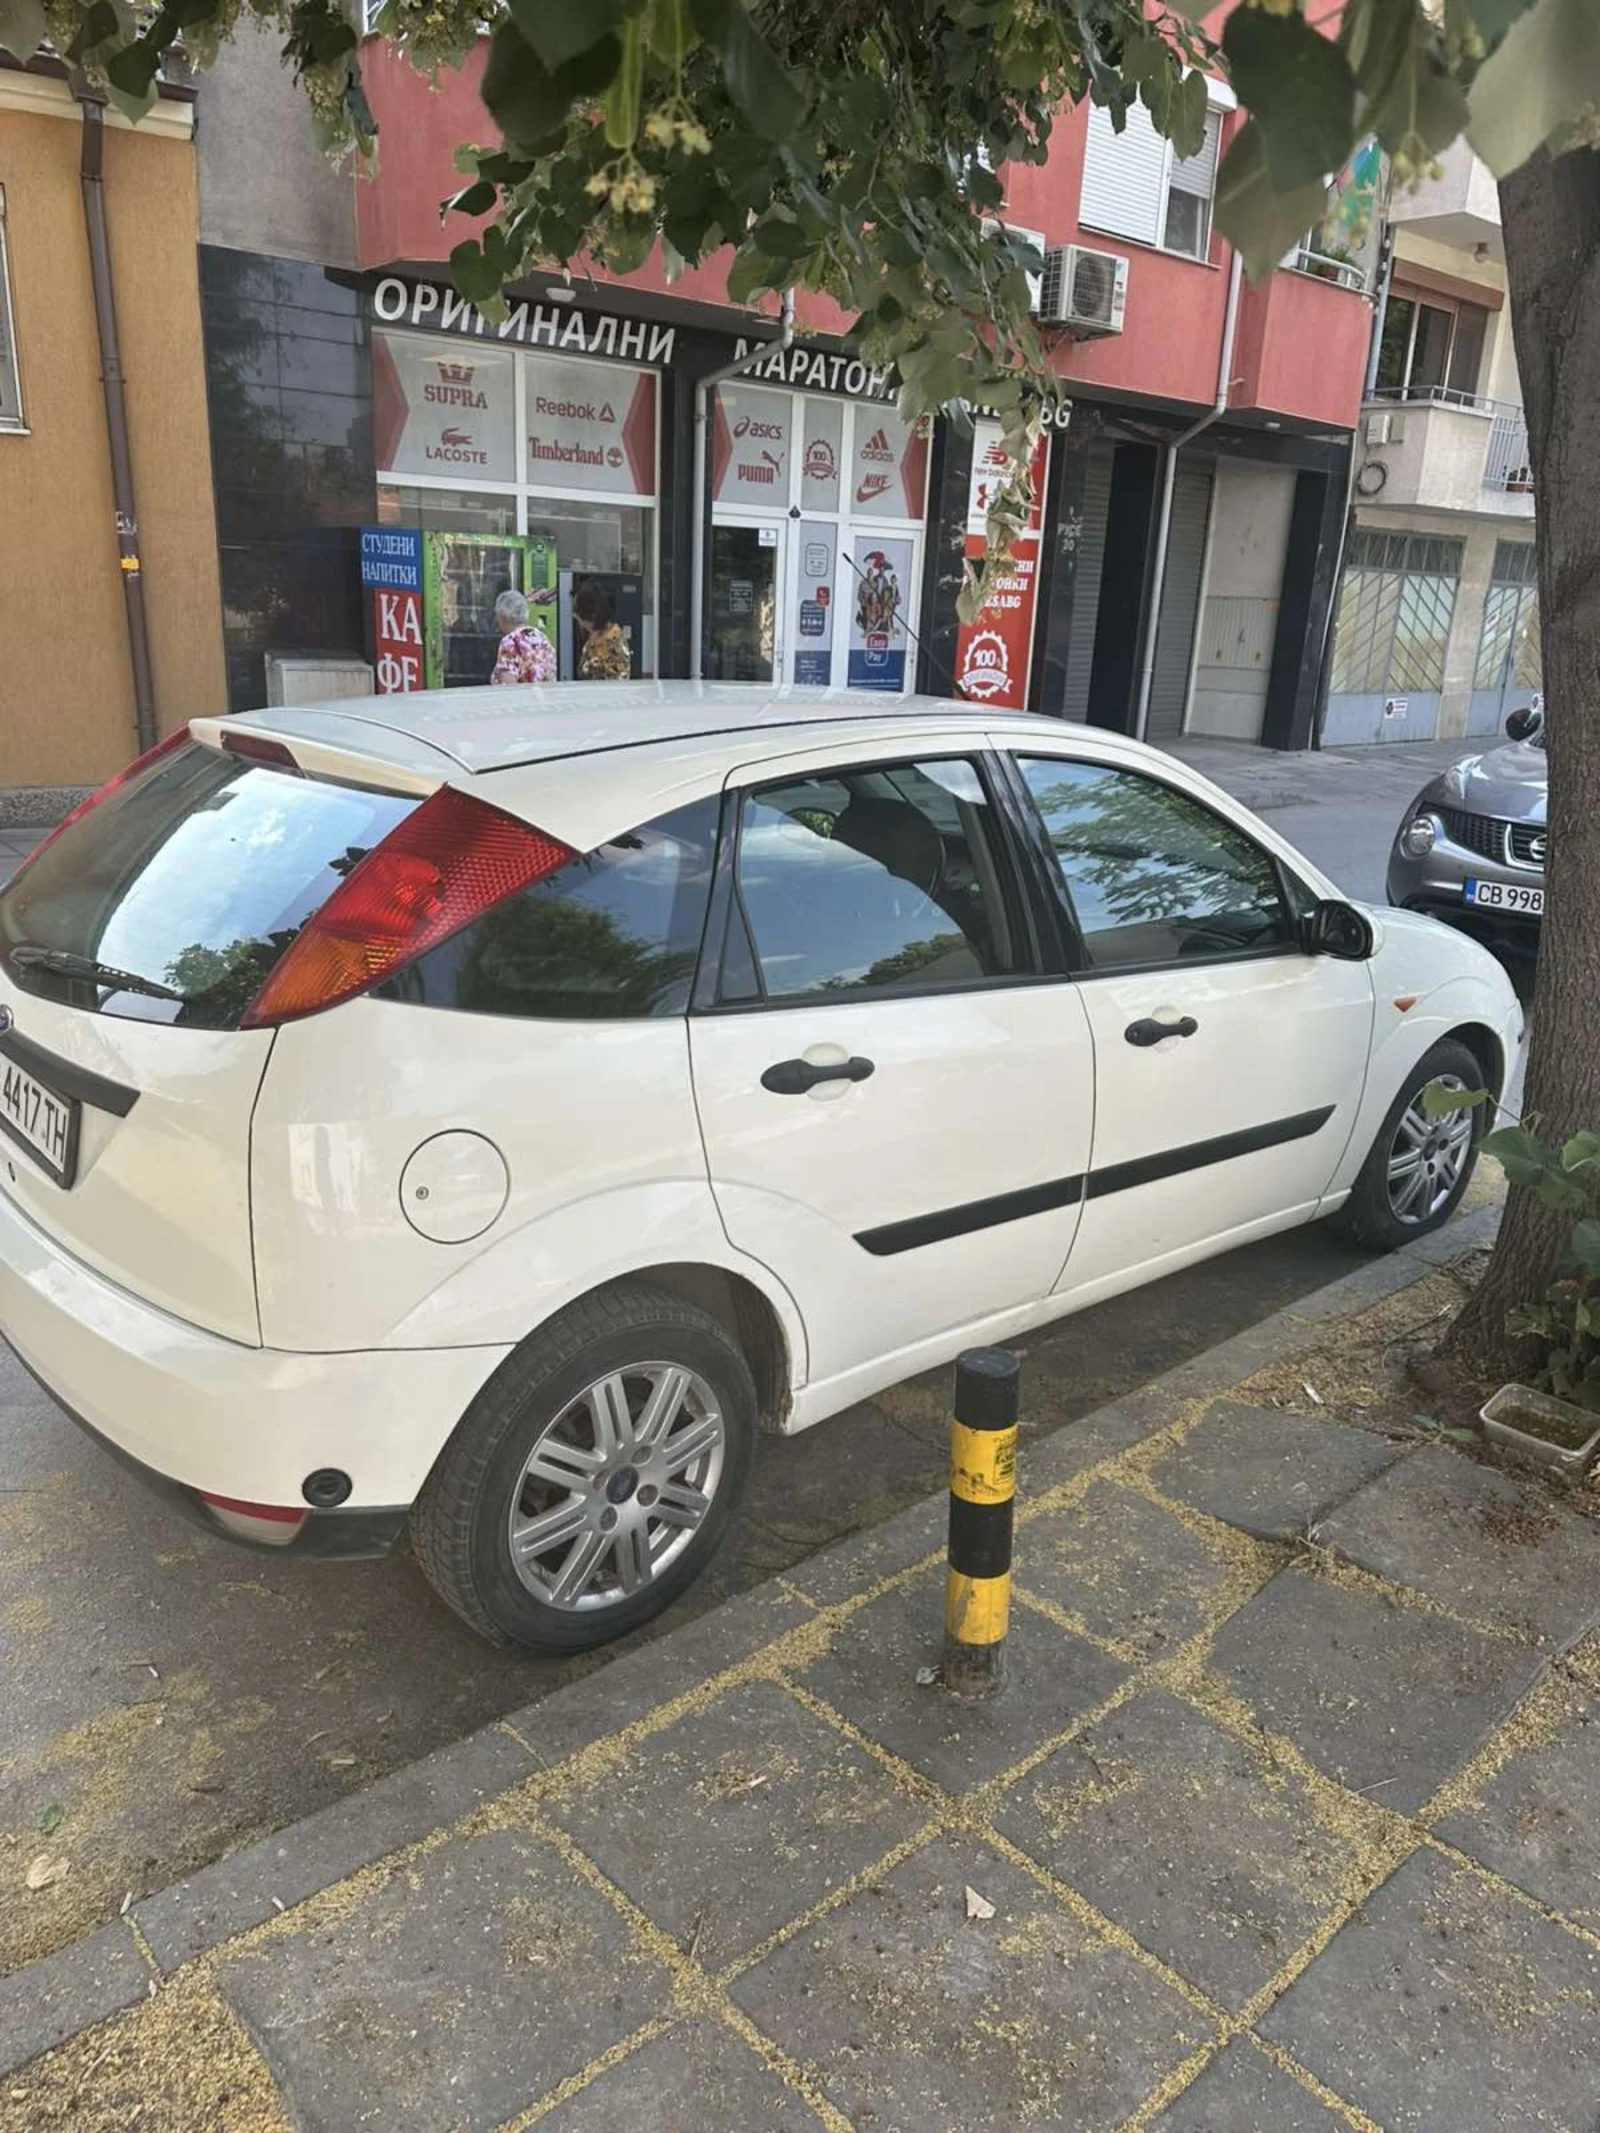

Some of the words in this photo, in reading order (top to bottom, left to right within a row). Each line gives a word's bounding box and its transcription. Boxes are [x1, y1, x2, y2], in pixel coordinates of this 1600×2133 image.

[374, 278, 676, 364] ОРИИНАЛНИ
[423, 383, 489, 410] SUPRA
[535, 396, 596, 421] Reebok
[425, 446, 488, 465] LACOSTE
[529, 436, 604, 466] Timberland
[860, 449, 895, 463] adidas
[738, 463, 774, 485] PUMA
[863, 473, 889, 488] NIKE
[361, 533, 415, 557] СТУДЕНИ
[361, 560, 417, 586] НАПИТКИ
[379, 593, 423, 645] КА
[1478, 884, 1503, 905] CB
[3, 1066, 41, 1133] 4417
